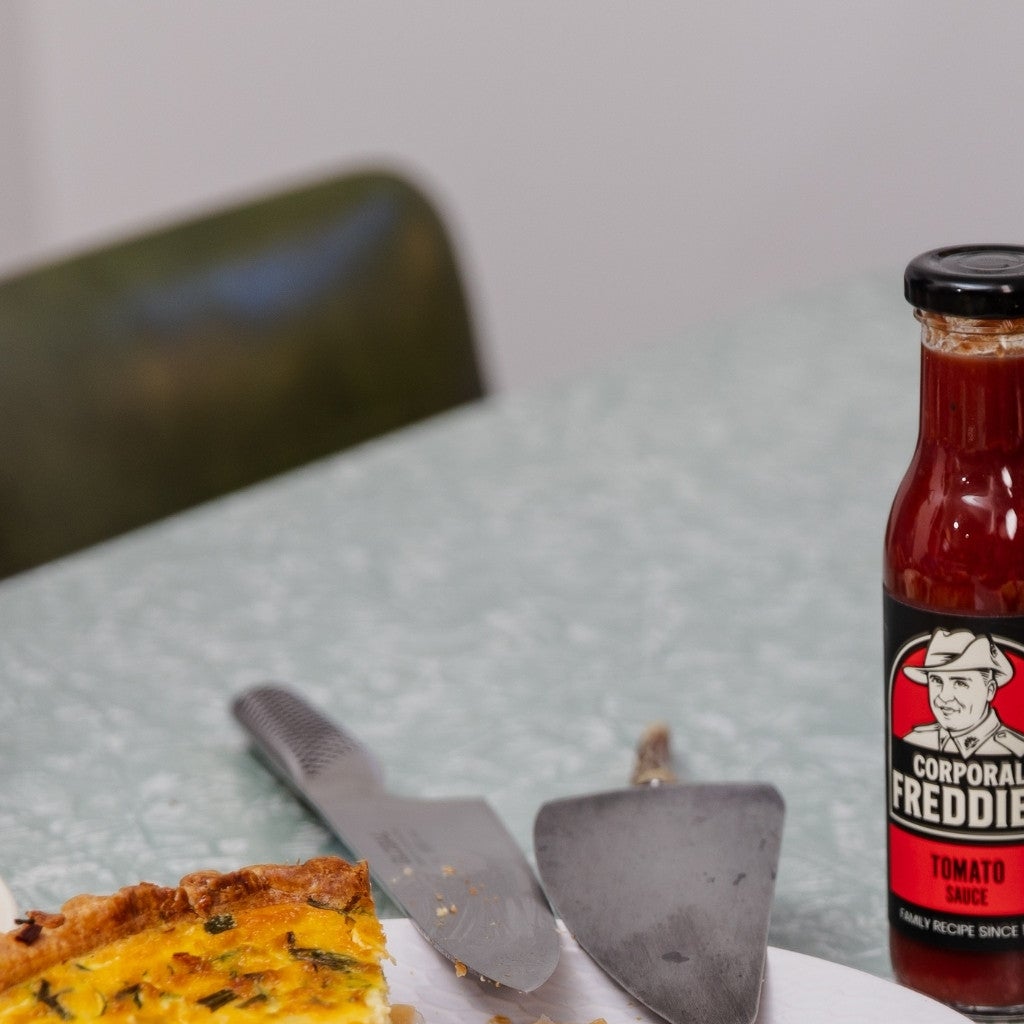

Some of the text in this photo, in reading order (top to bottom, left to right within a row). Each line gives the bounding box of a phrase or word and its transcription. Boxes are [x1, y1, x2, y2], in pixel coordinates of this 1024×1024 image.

[931, 854, 1005, 885] TOMATO
[946, 885, 988, 906] SAUCE
[899, 907, 931, 929] FAMILY
[934, 919, 975, 937] RECIPE
[979, 924, 1019, 937] SINCE
